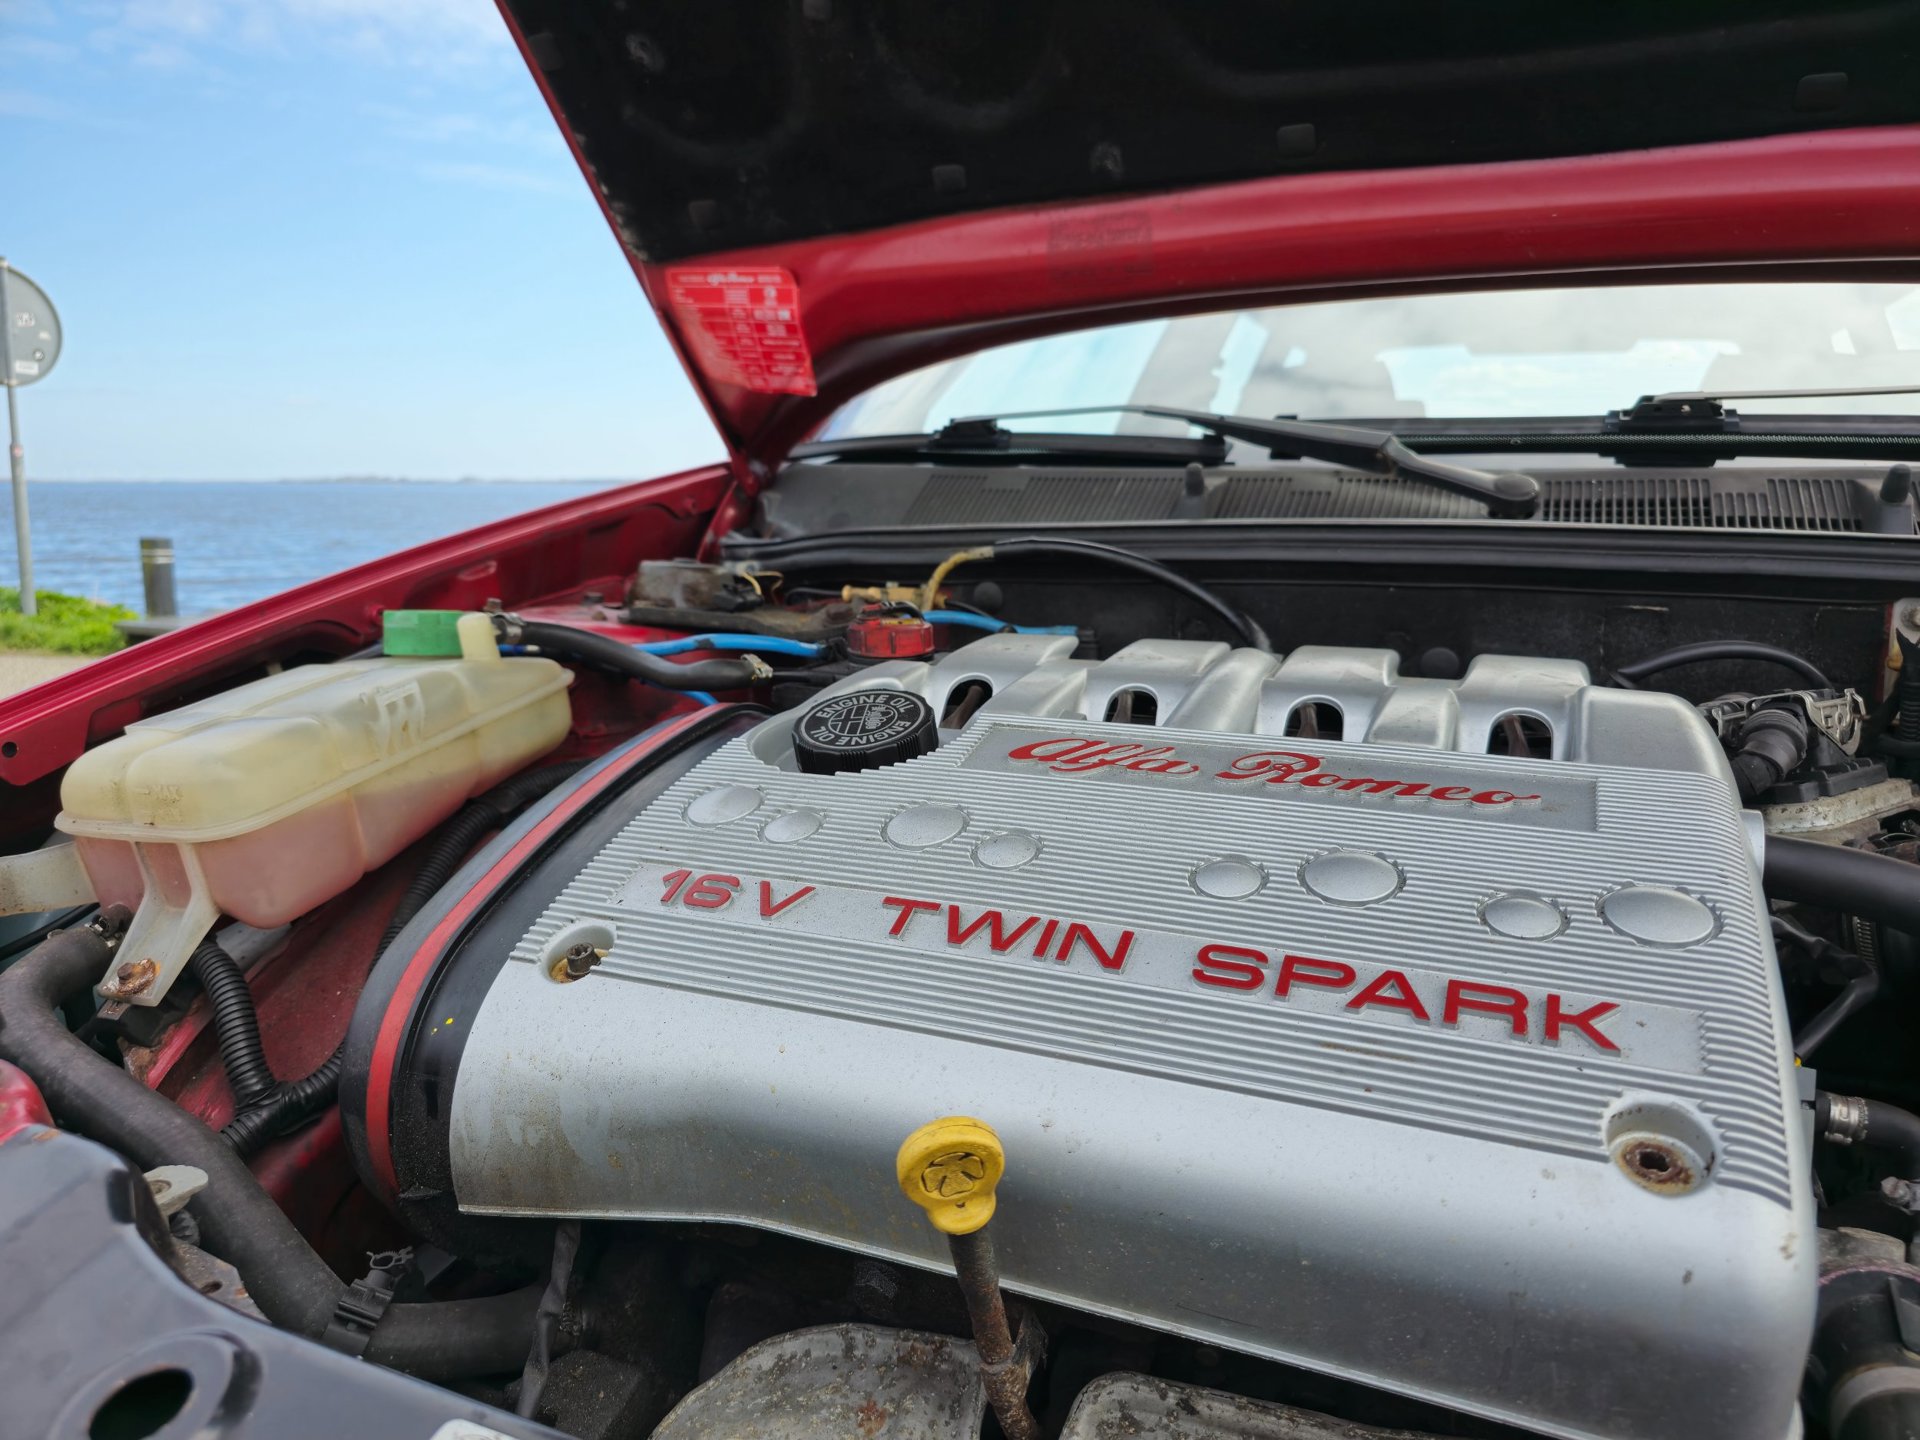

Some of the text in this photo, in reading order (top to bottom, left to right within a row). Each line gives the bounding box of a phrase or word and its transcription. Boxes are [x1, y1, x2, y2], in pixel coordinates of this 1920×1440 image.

[816, 694, 915, 718] ENGINE OIL
[810, 720, 912, 746] ENGINE OIL
[1007, 738, 1542, 807] Alfa Romeo
[882, 896, 1135, 973] TWIN
[1191, 944, 1622, 1055] SPARK
